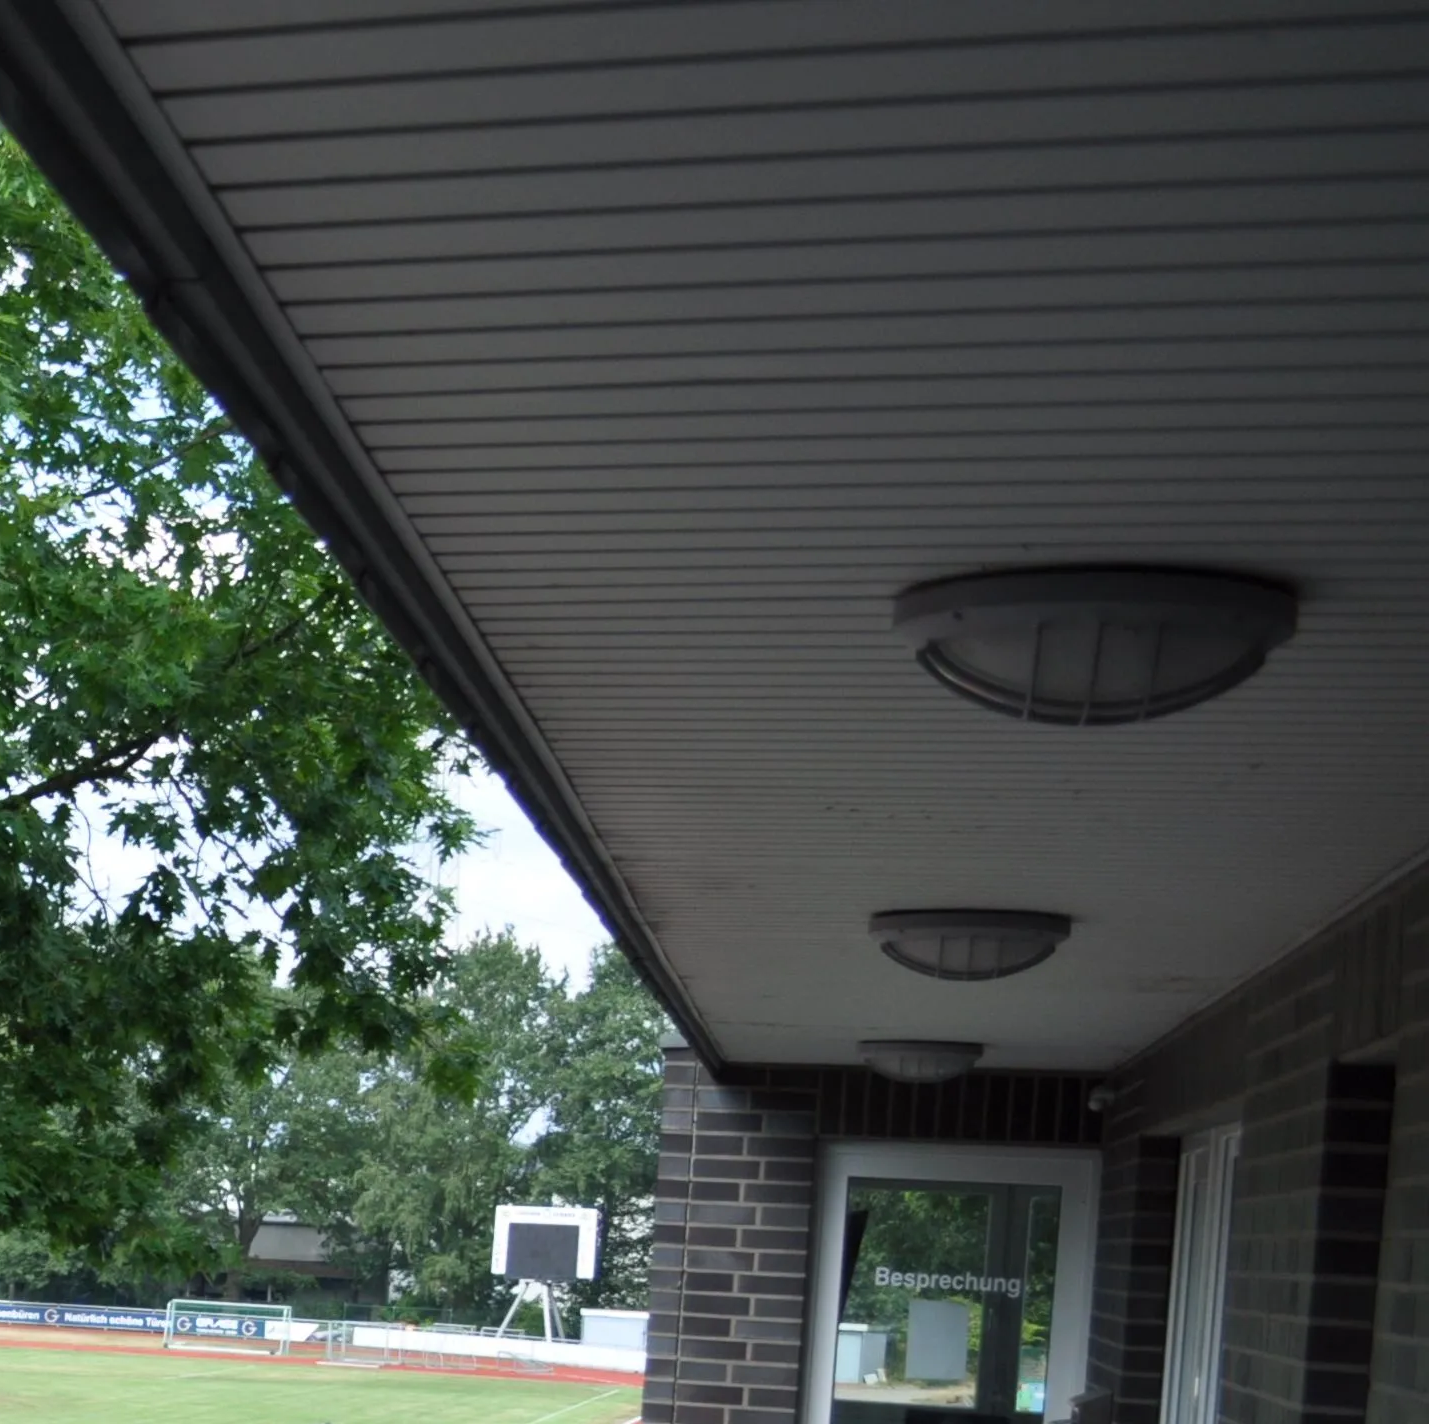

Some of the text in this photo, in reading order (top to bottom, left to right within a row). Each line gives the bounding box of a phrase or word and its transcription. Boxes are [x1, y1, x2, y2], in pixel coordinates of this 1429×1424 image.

[874, 1266, 1021, 1298] Besprechung
[64, 1312, 107, 1324] Natürlich
[109, 1315, 143, 1326] schöne
